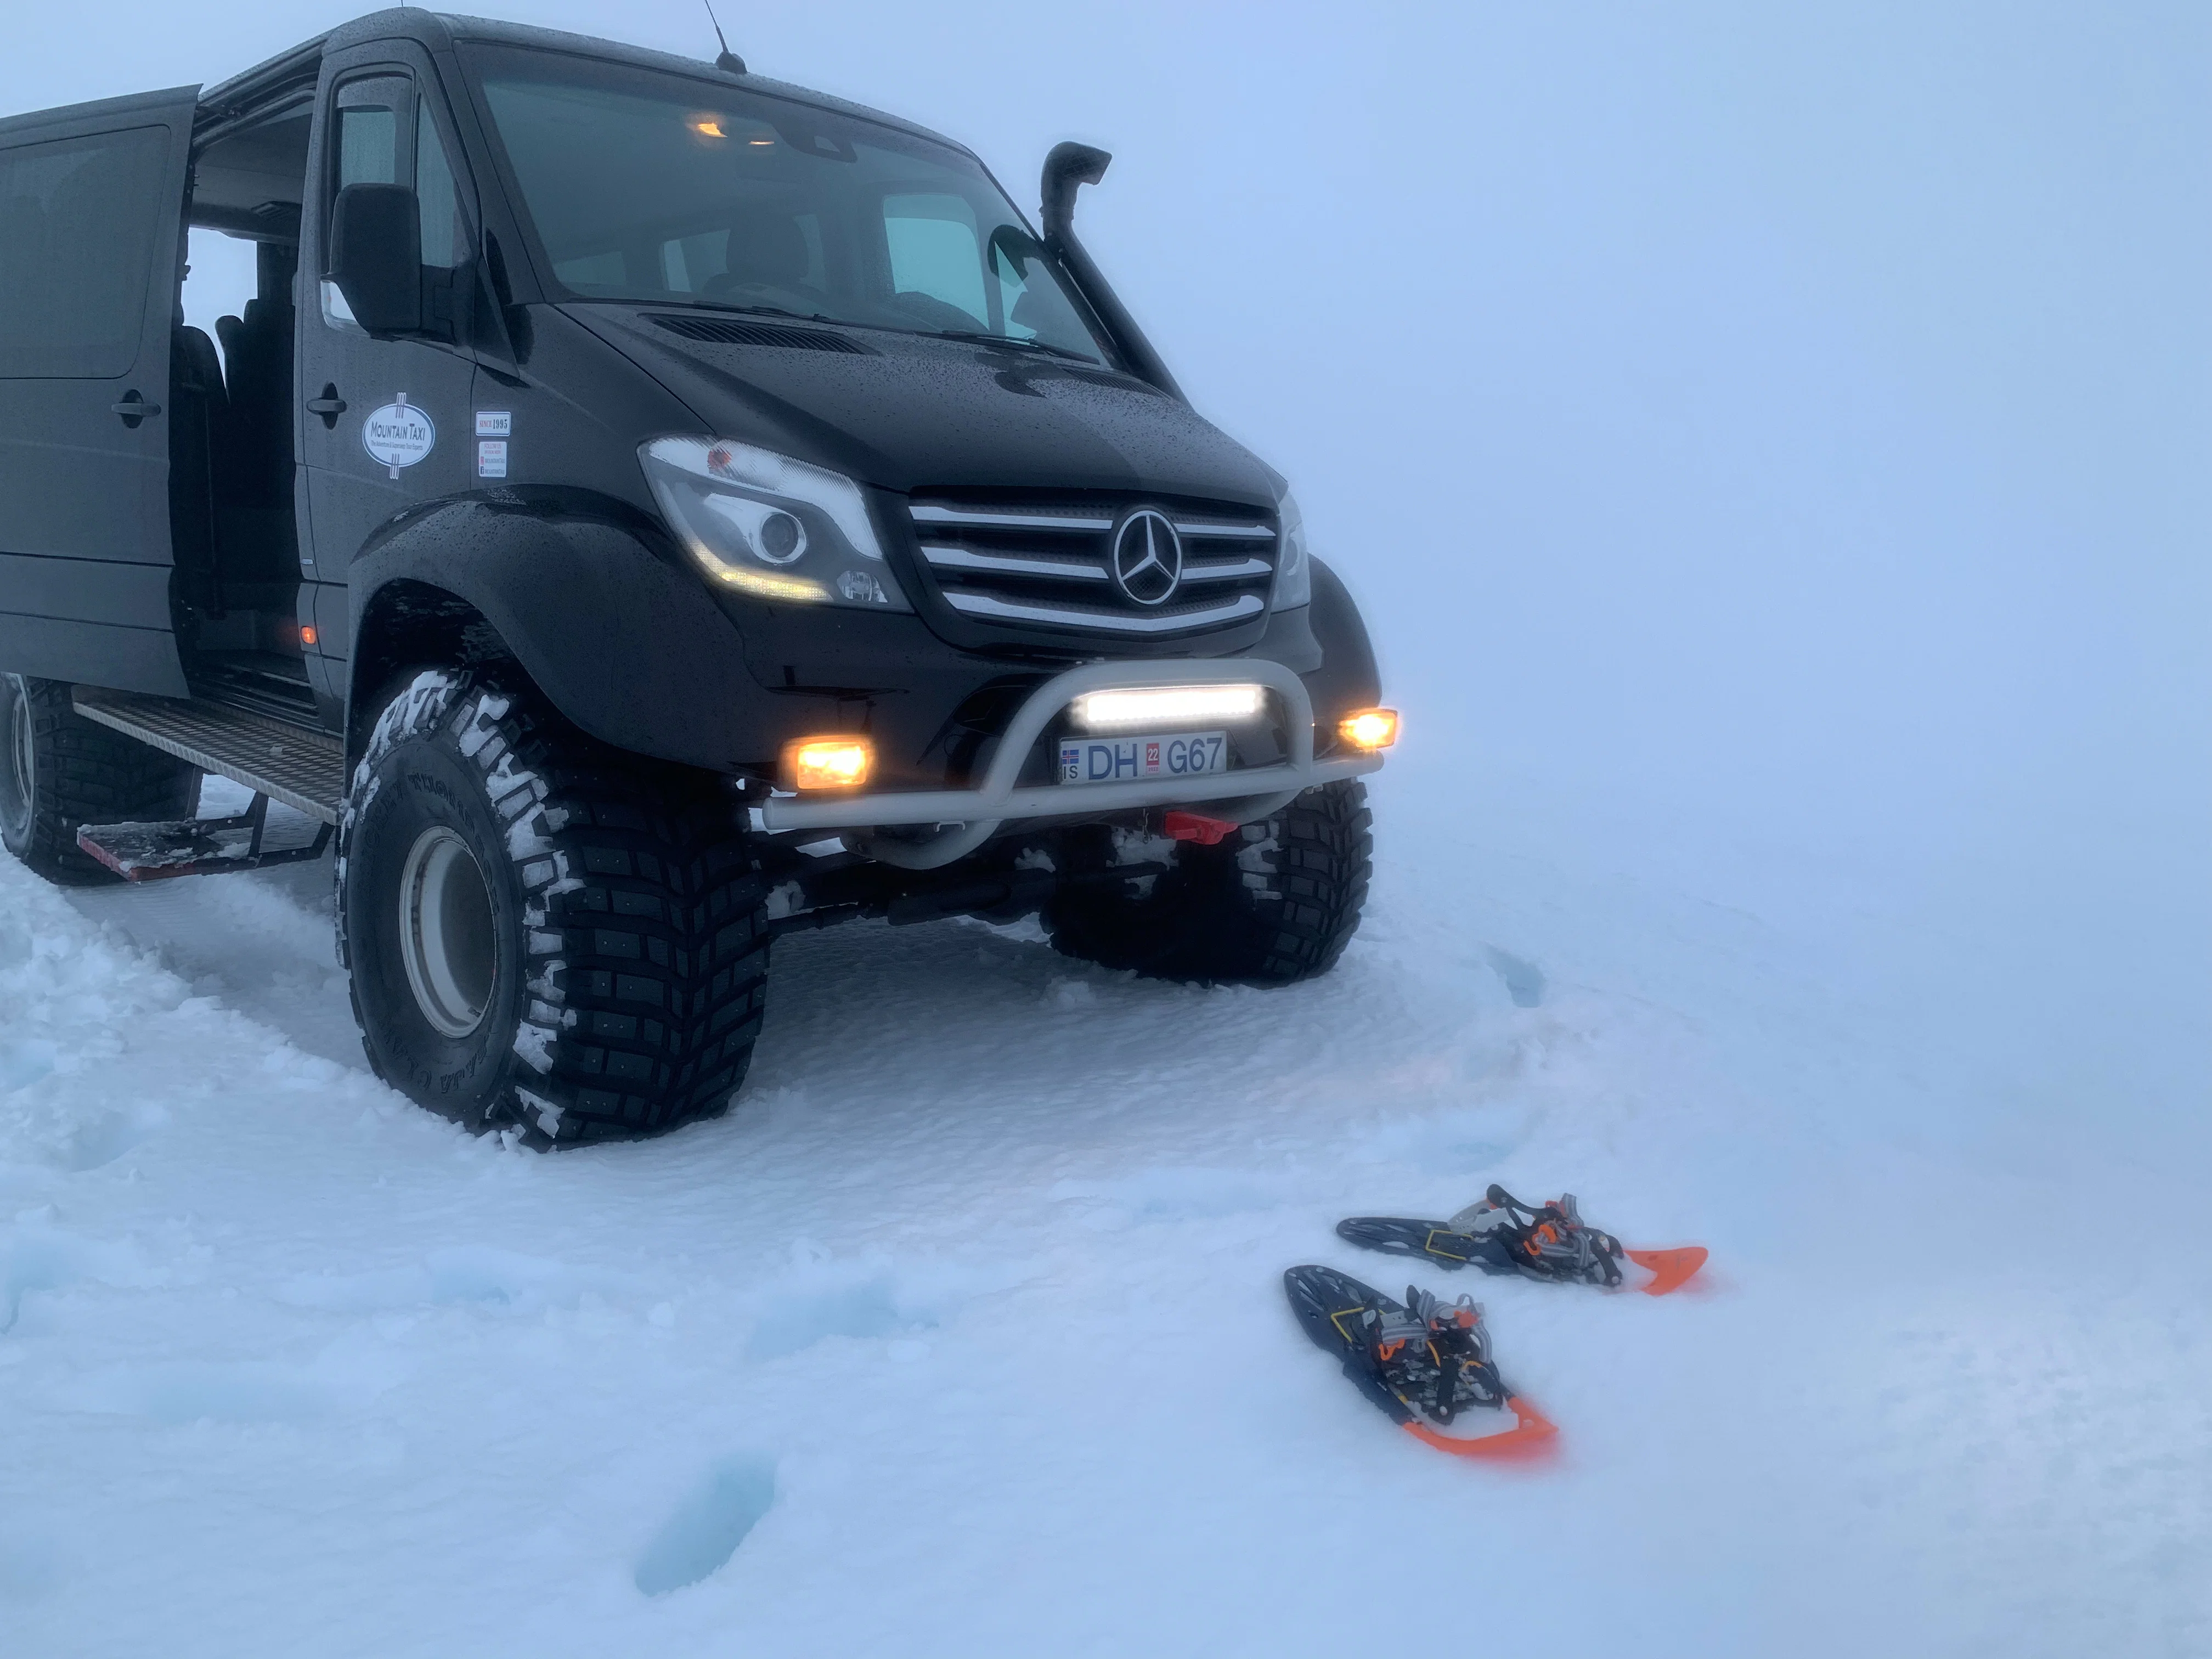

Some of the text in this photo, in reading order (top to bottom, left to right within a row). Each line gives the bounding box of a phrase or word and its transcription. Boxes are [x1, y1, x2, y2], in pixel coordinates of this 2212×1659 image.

[371, 421, 425, 441] MOUNTAIN TAXI
[479, 419, 507, 430] SINCE 1995
[1063, 737, 1223, 780] IS DH G67
[1148, 748, 1158, 761] 22
